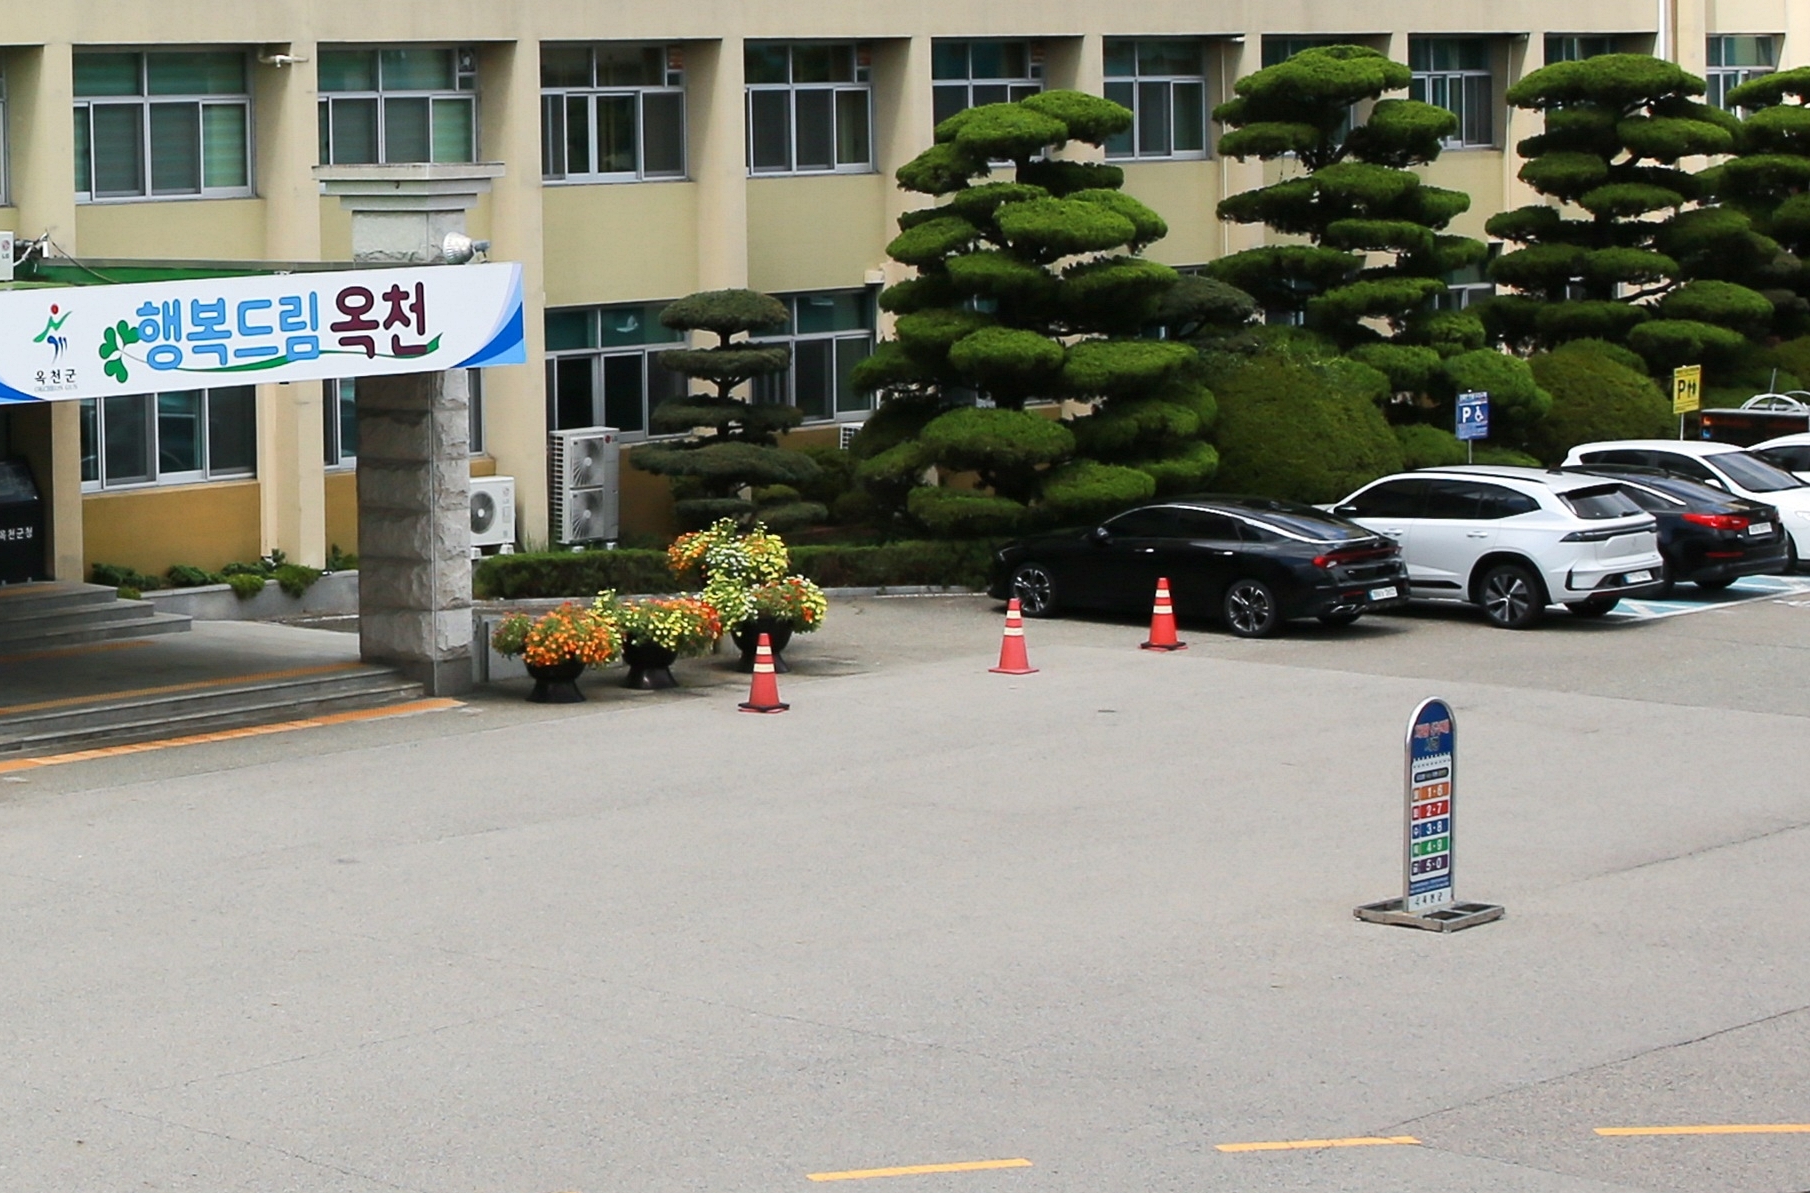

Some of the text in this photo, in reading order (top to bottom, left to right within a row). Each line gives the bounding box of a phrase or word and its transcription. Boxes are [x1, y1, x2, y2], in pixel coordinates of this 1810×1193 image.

[136, 281, 428, 371] 행복드림 옥천
[34, 368, 77, 385] 옥천군
[1678, 380, 1686, 400] P
[1463, 407, 1471, 423] P
